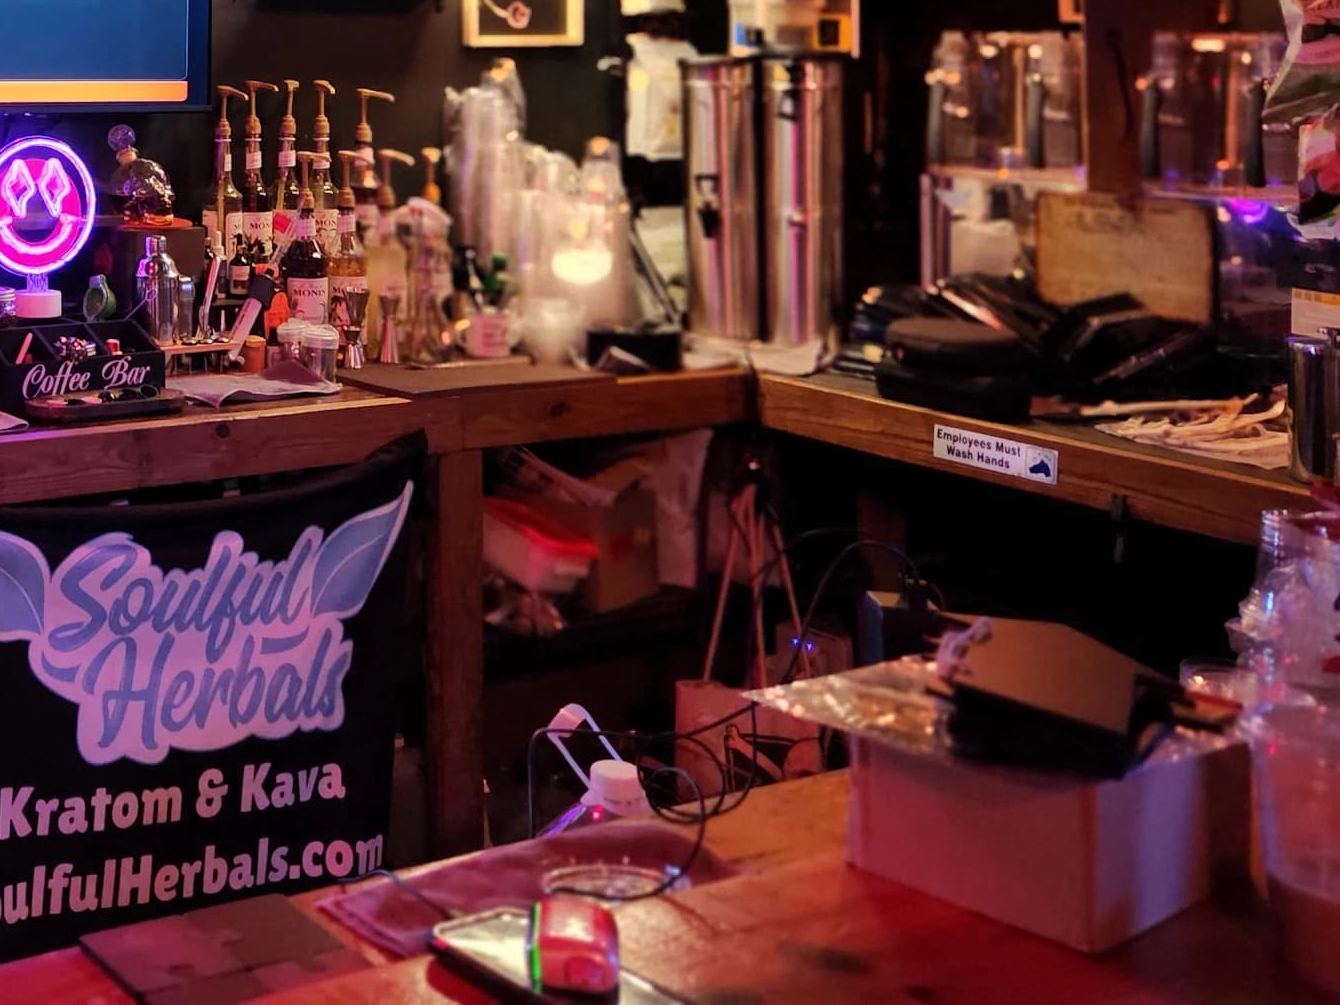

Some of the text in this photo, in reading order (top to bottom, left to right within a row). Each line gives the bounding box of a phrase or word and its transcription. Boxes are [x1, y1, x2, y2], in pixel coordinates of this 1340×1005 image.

[249, 222, 271, 230] MON
[315, 220, 337, 228] MON
[22, 355, 151, 401] Coffee Bar
[936, 428, 1021, 457] Employees Must
[946, 445, 1010, 469] Wash Hands
[48, 538, 309, 661] Soulful
[82, 629, 351, 751] Herbals
[195, 768, 229, 818] &
[240, 762, 346, 813] Kava
